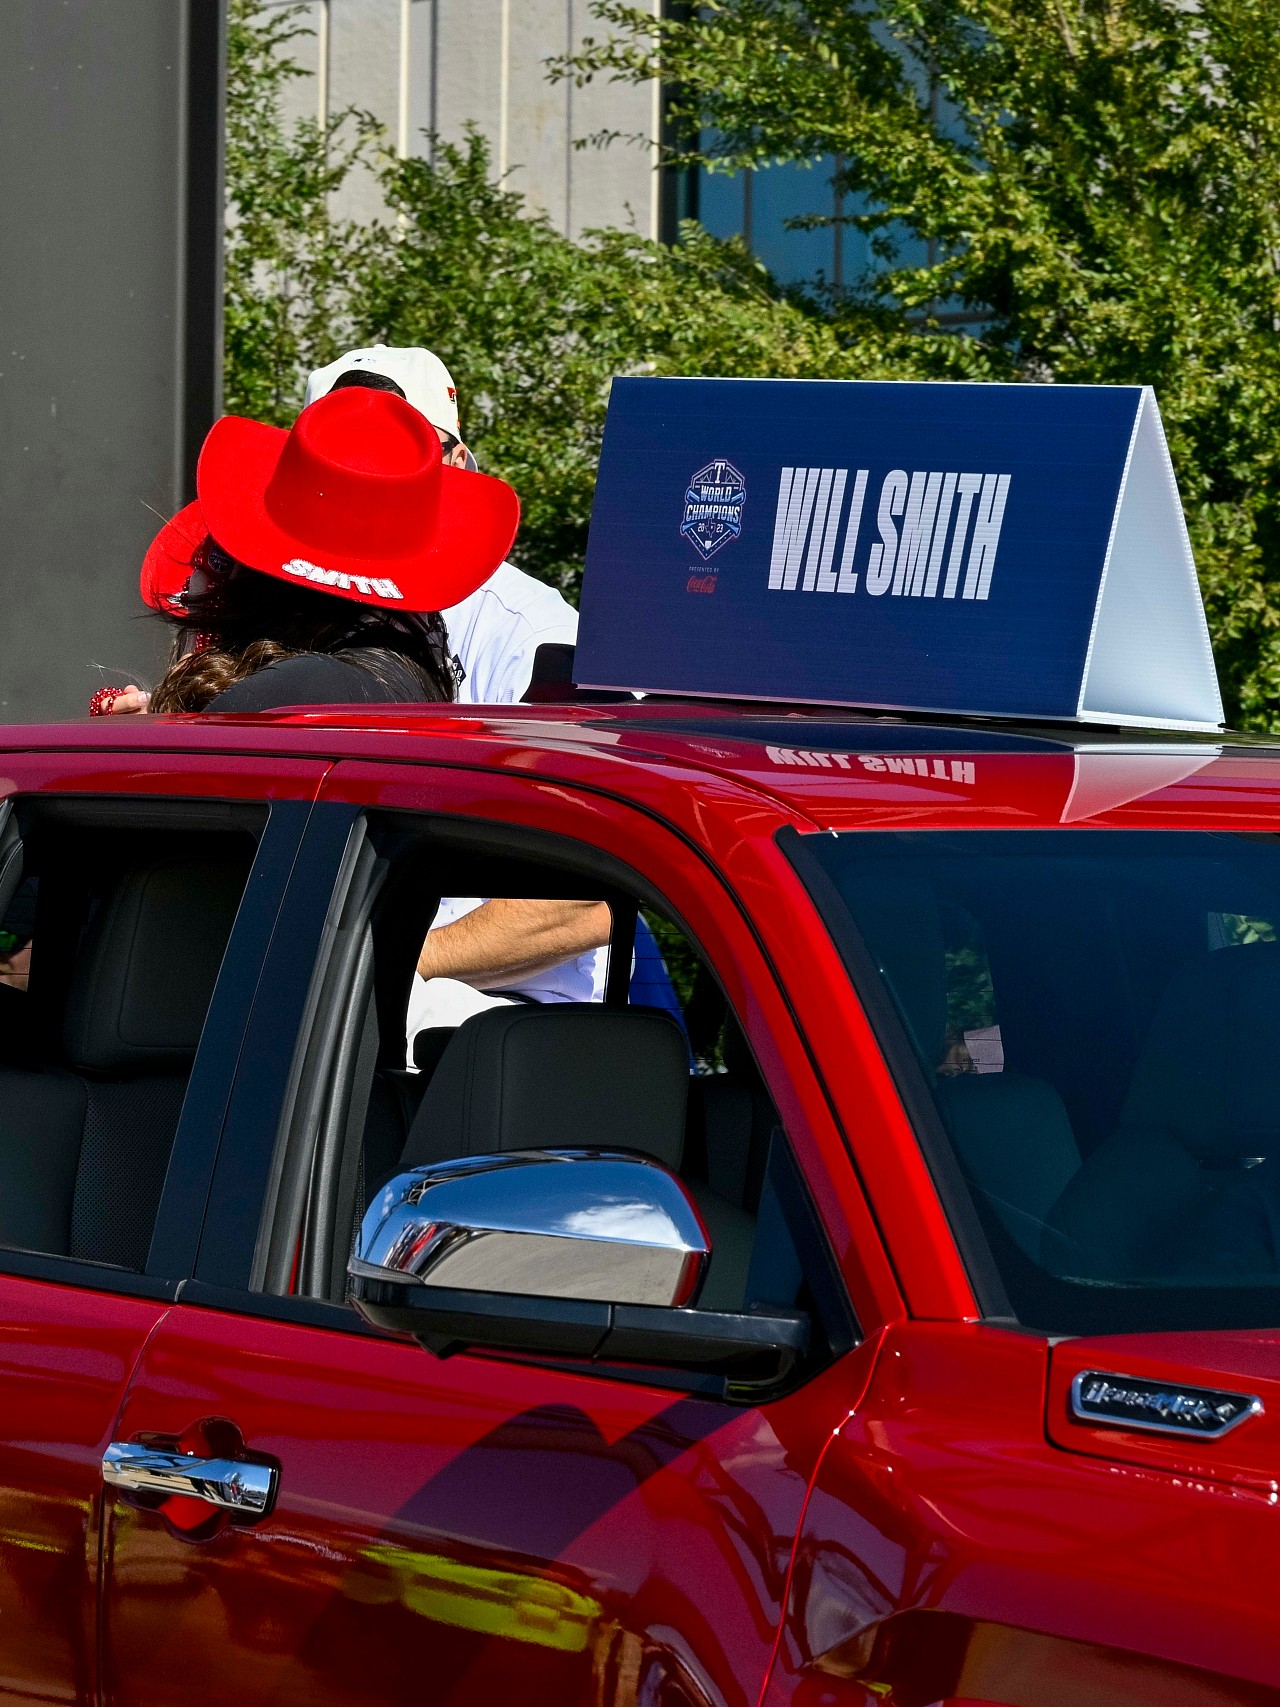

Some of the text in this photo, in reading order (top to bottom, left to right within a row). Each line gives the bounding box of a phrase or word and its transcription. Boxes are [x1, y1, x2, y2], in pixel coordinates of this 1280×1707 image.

[700, 485, 733, 503] WORLD
[685, 504, 741, 524] CHAMPIONS
[697, 523, 724, 533] 20 23
[767, 466, 1012, 601] WILL SMITH
[281, 558, 405, 600] SMITH
